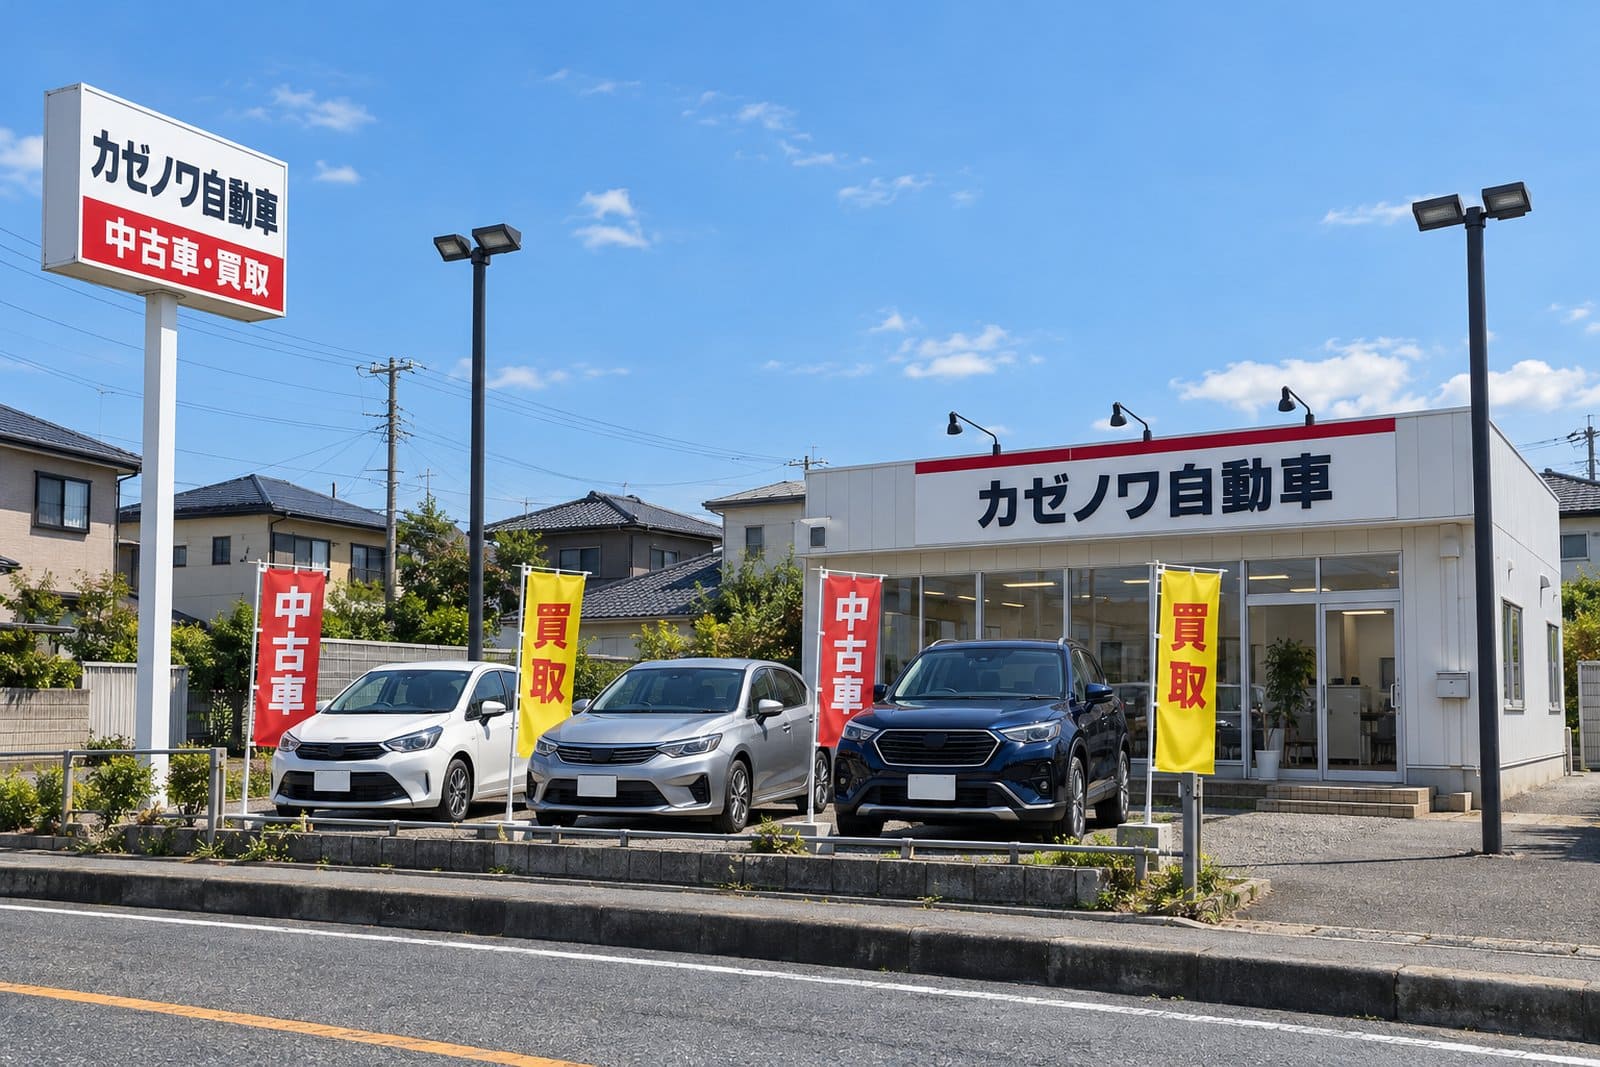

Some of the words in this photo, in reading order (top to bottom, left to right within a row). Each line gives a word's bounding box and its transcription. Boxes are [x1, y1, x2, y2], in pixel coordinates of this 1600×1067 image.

[91, 129, 278, 236] カゼノワ自動車
[105, 217, 269, 298] 中古車・買取
[978, 453, 1333, 528] カゼノワ自動車
[268, 585, 312, 716] 中古車
[530, 603, 571, 705] 買取
[831, 591, 869, 715] 中古車
[1168, 602, 1209, 710] 買取
